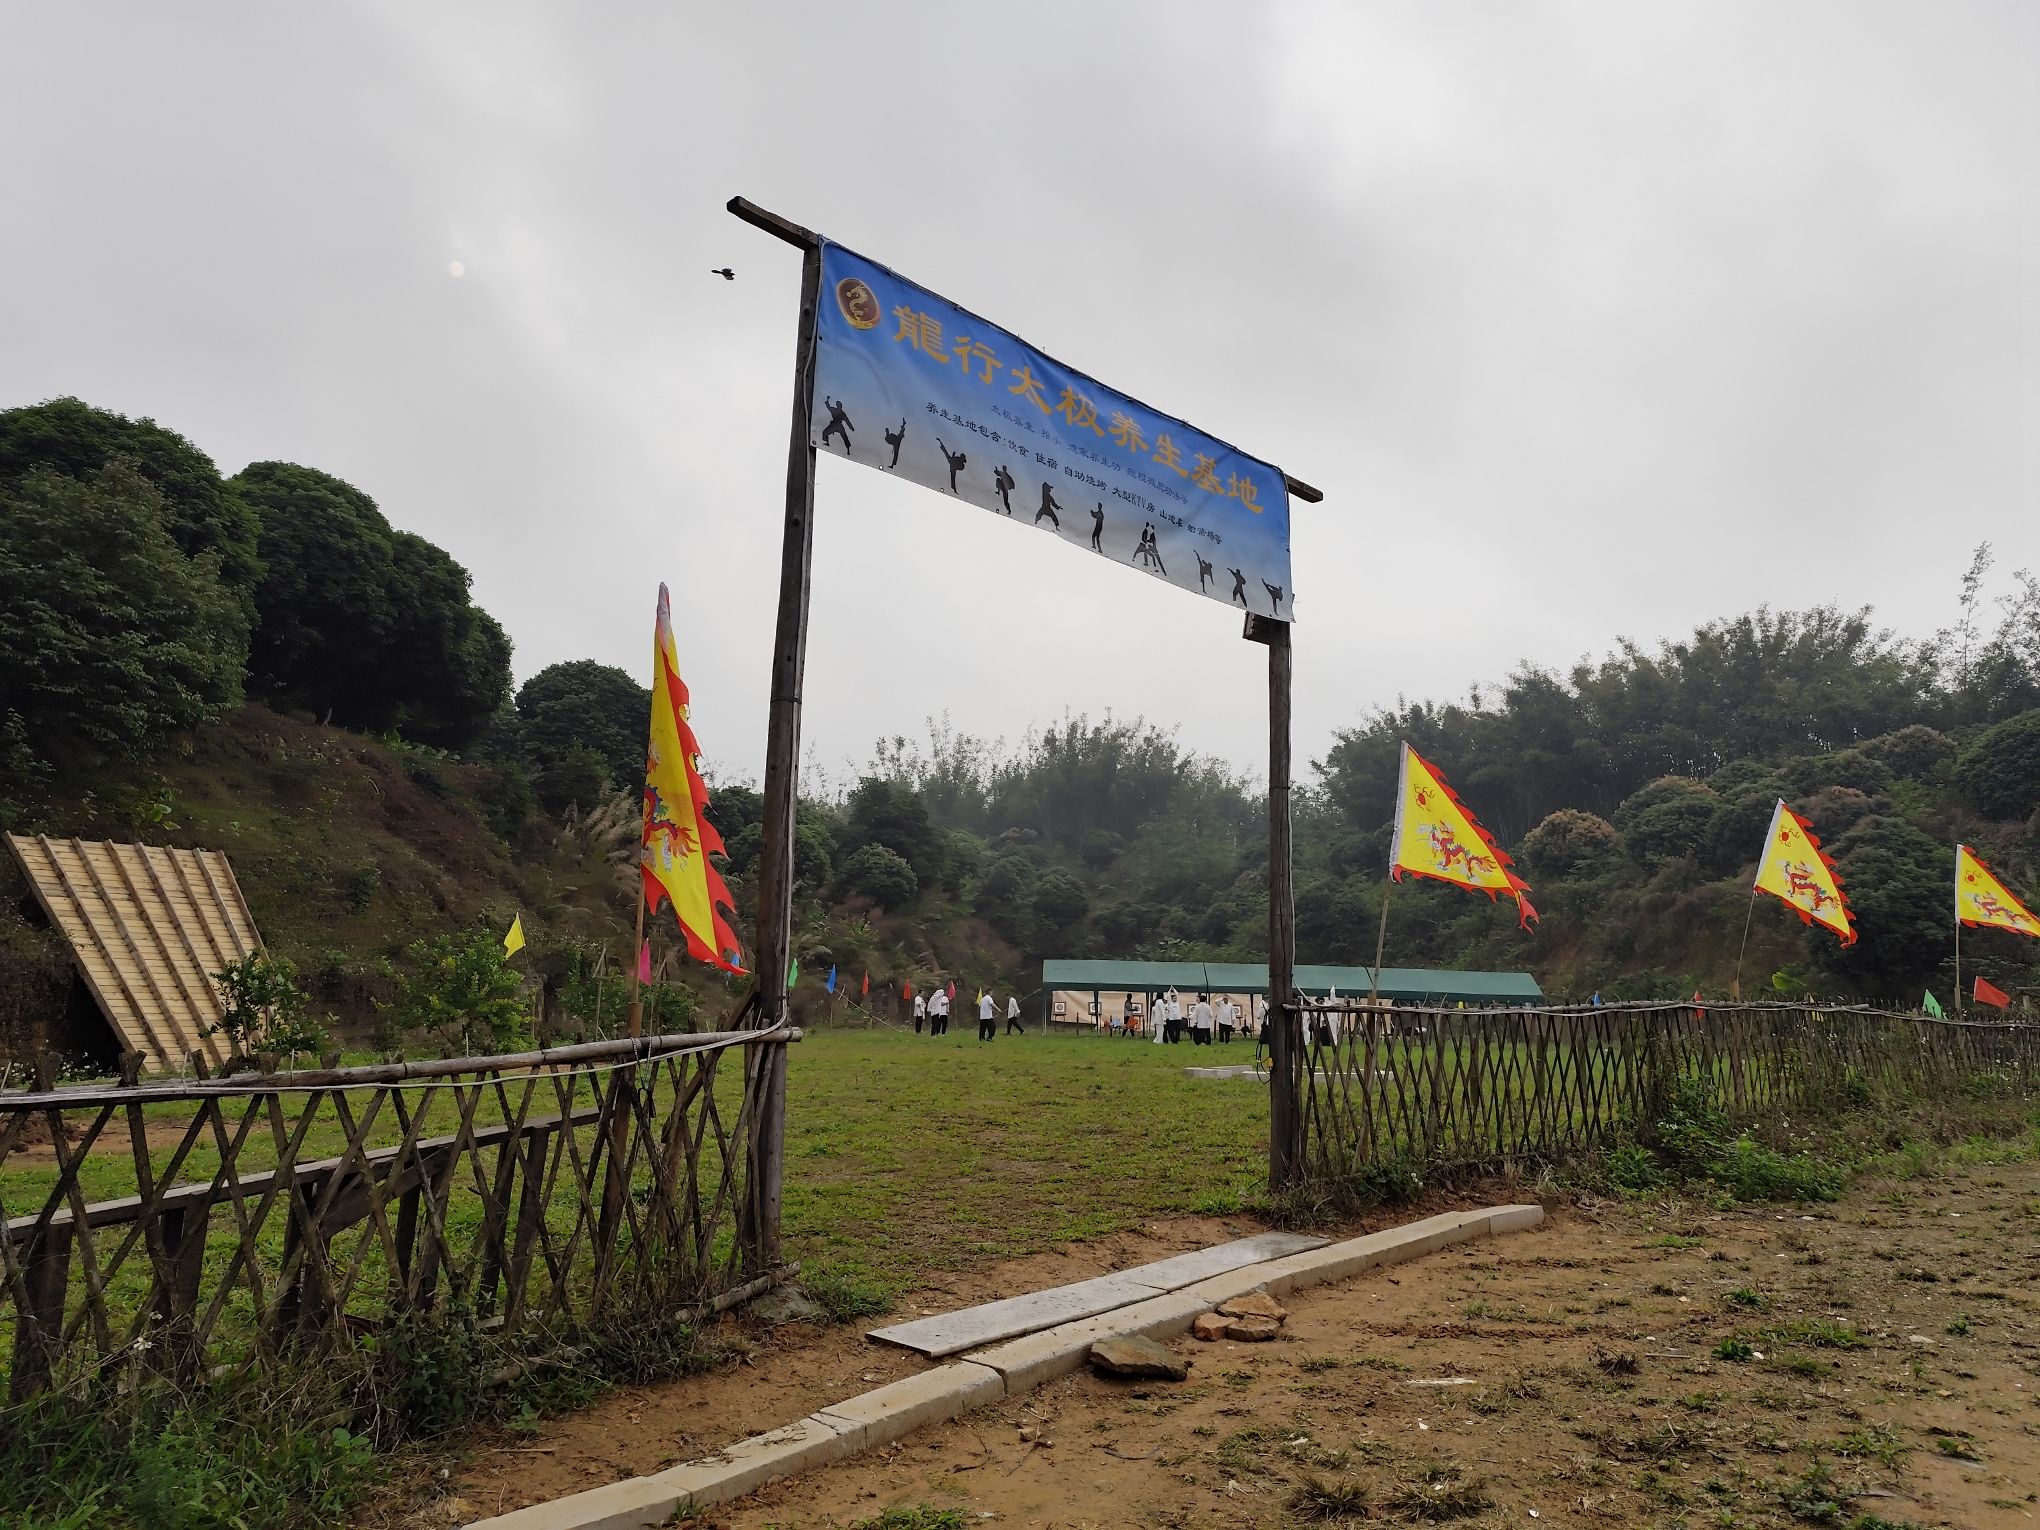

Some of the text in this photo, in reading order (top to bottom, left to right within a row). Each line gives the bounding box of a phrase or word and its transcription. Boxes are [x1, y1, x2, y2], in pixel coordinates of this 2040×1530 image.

[892, 303, 1265, 513] 龍行太极养生基地
[991, 404, 1035, 433] 太极养生
[1035, 453, 1058, 470] 住宿
[1064, 466, 1107, 490] 自助烧烤
[1112, 486, 1156, 512] 大型KTV房
